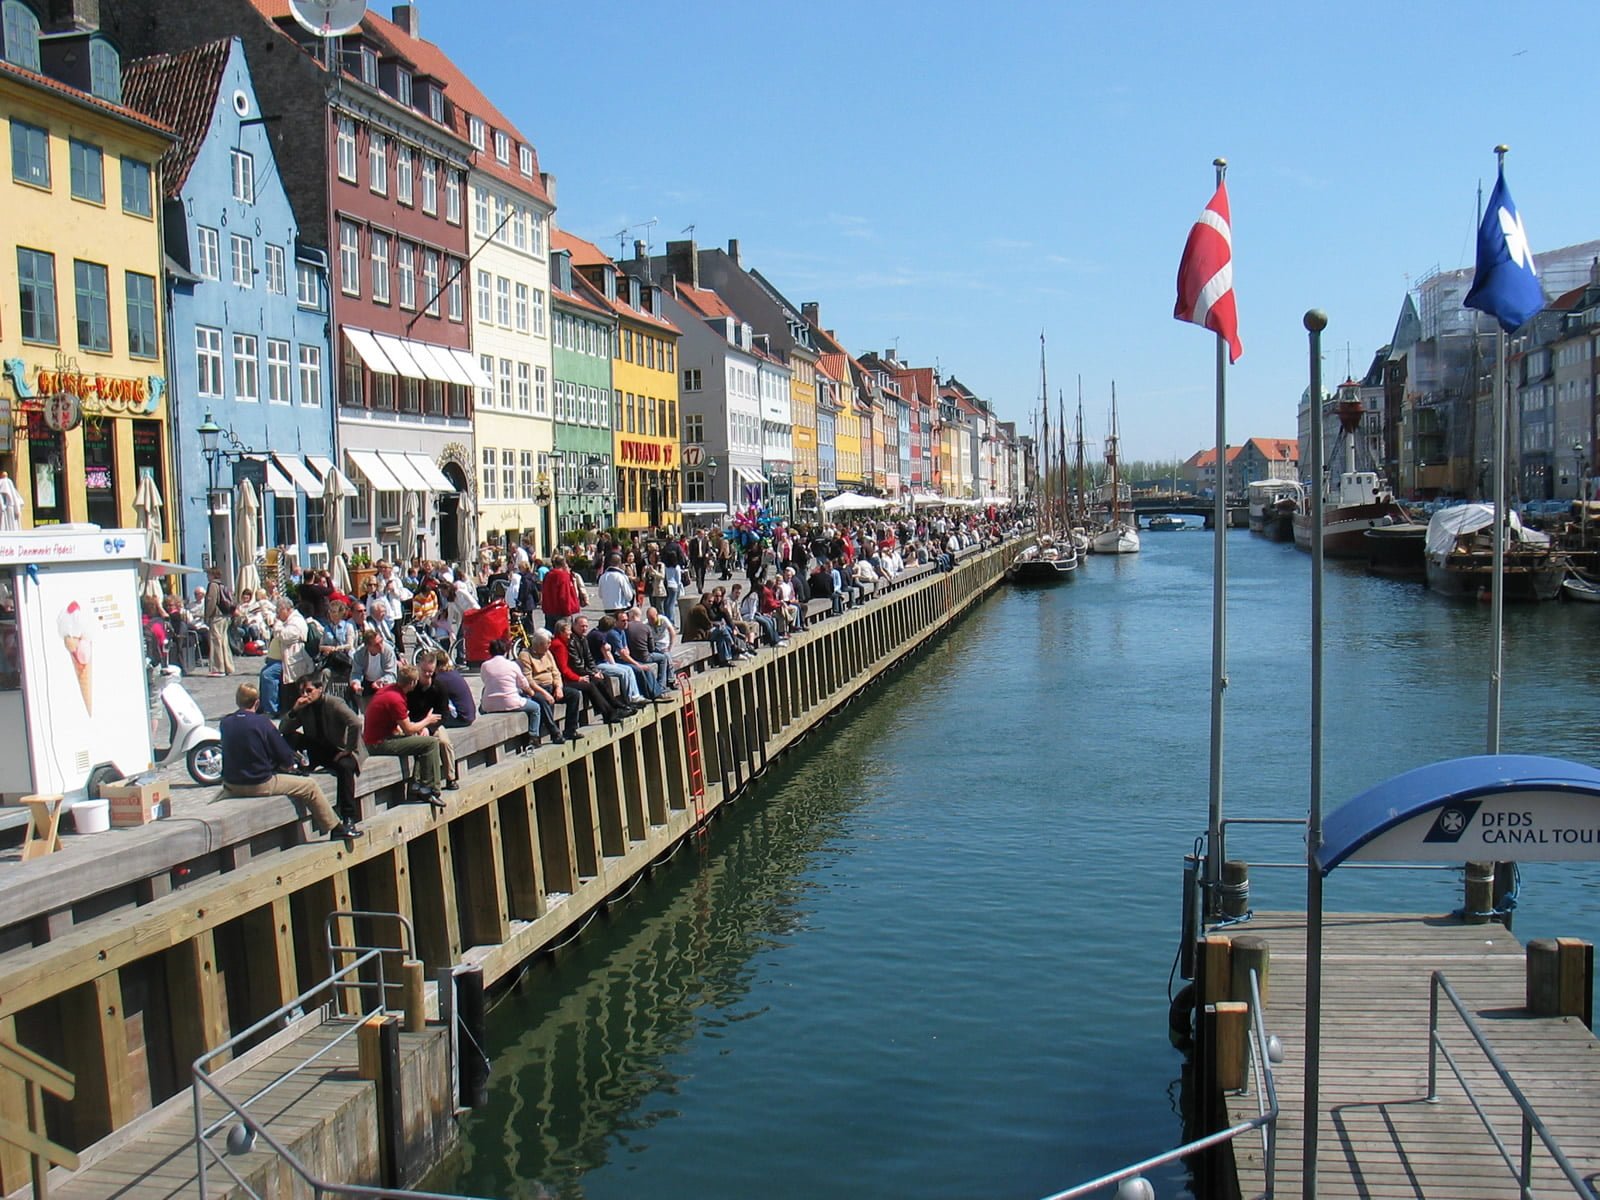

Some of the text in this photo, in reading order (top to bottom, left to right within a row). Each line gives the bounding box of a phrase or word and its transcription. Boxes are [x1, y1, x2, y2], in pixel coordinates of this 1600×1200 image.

[621, 440, 660, 465] NYHAVN
[683, 447, 699, 464] 17
[1482, 812, 1532, 826] DFDS
[1482, 829, 1548, 843] CANAL
